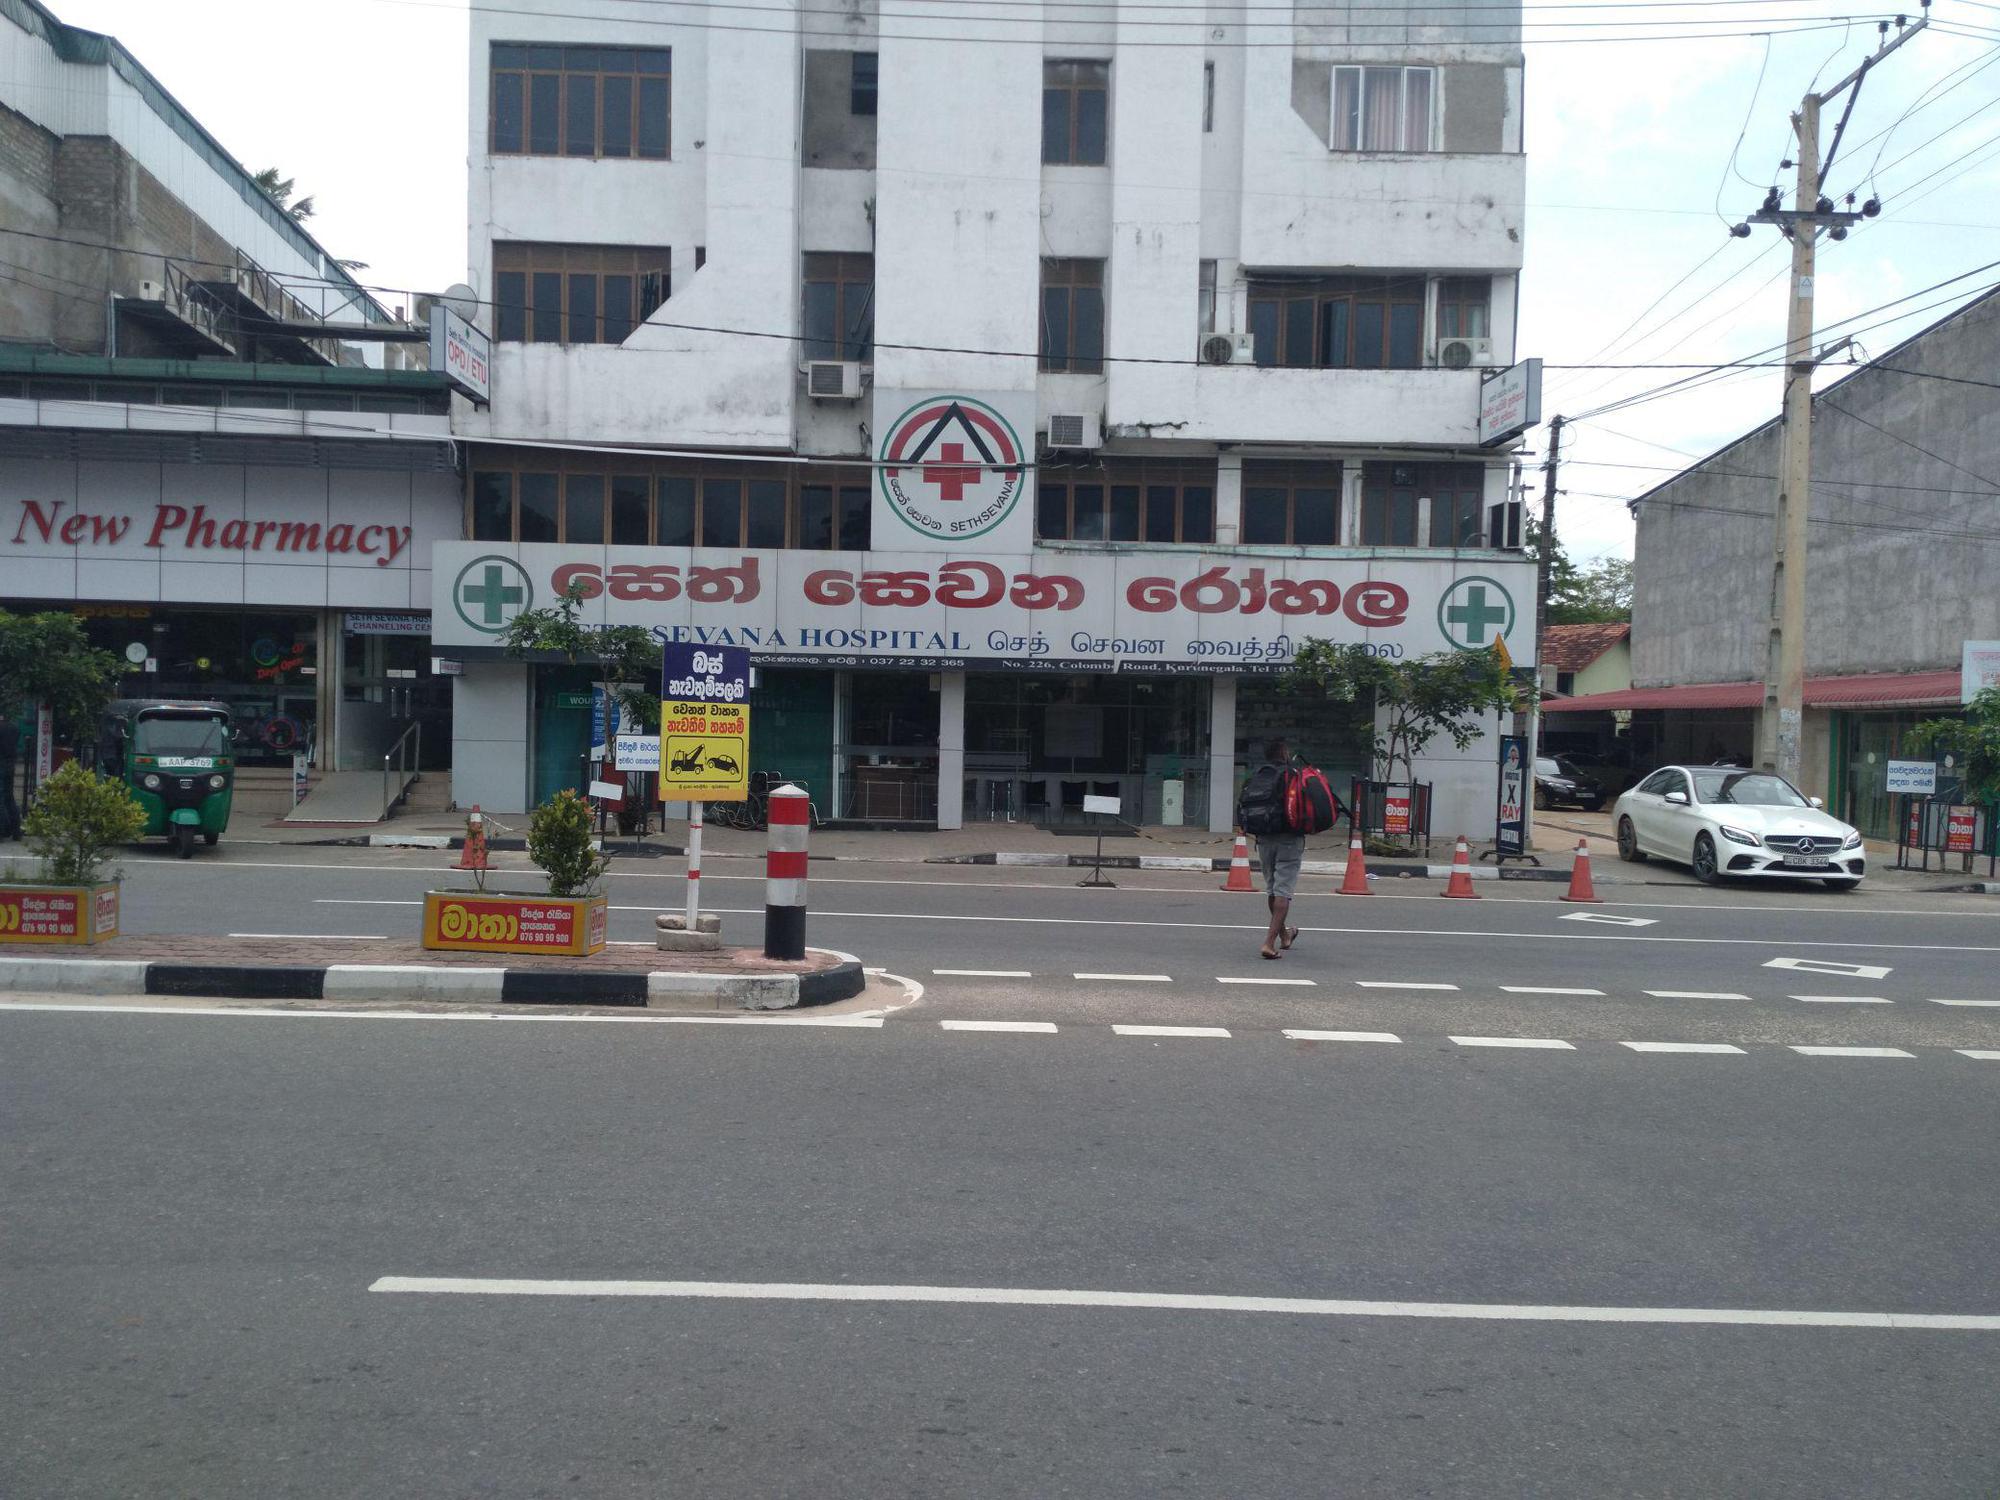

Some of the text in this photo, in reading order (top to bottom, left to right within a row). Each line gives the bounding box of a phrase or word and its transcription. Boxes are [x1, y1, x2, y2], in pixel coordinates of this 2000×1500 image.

[448, 340, 465, 370] OPD
[472, 358, 487, 384] ETU
[906, 506, 942, 531] සෙවන
[12, 500, 413, 567] New Pharmacy
[550, 557, 1409, 628] සෙත් සෙවන රෝහල
[353, 623, 412, 631] CHANNELING
[652, 624, 787, 647] SEVANA
[799, 628, 971, 651] HOSPITAL
[987, 630, 1050, 658] செத்
[1070, 631, 1165, 654] செவன
[692, 651, 724, 674] බස්
[869, 658, 894, 666] 037
[940, 659, 965, 667] 365
[1002, 660, 1024, 668] No.
[1250, 665, 1271, 673] Tel
[672, 704, 739, 716] වෙනත් වාහන
[1507, 783, 1516, 804] X
[1502, 804, 1521, 821] RAY
[440, 904, 518, 941] මාතා
[520, 932, 569, 943] 076 90 90 900
